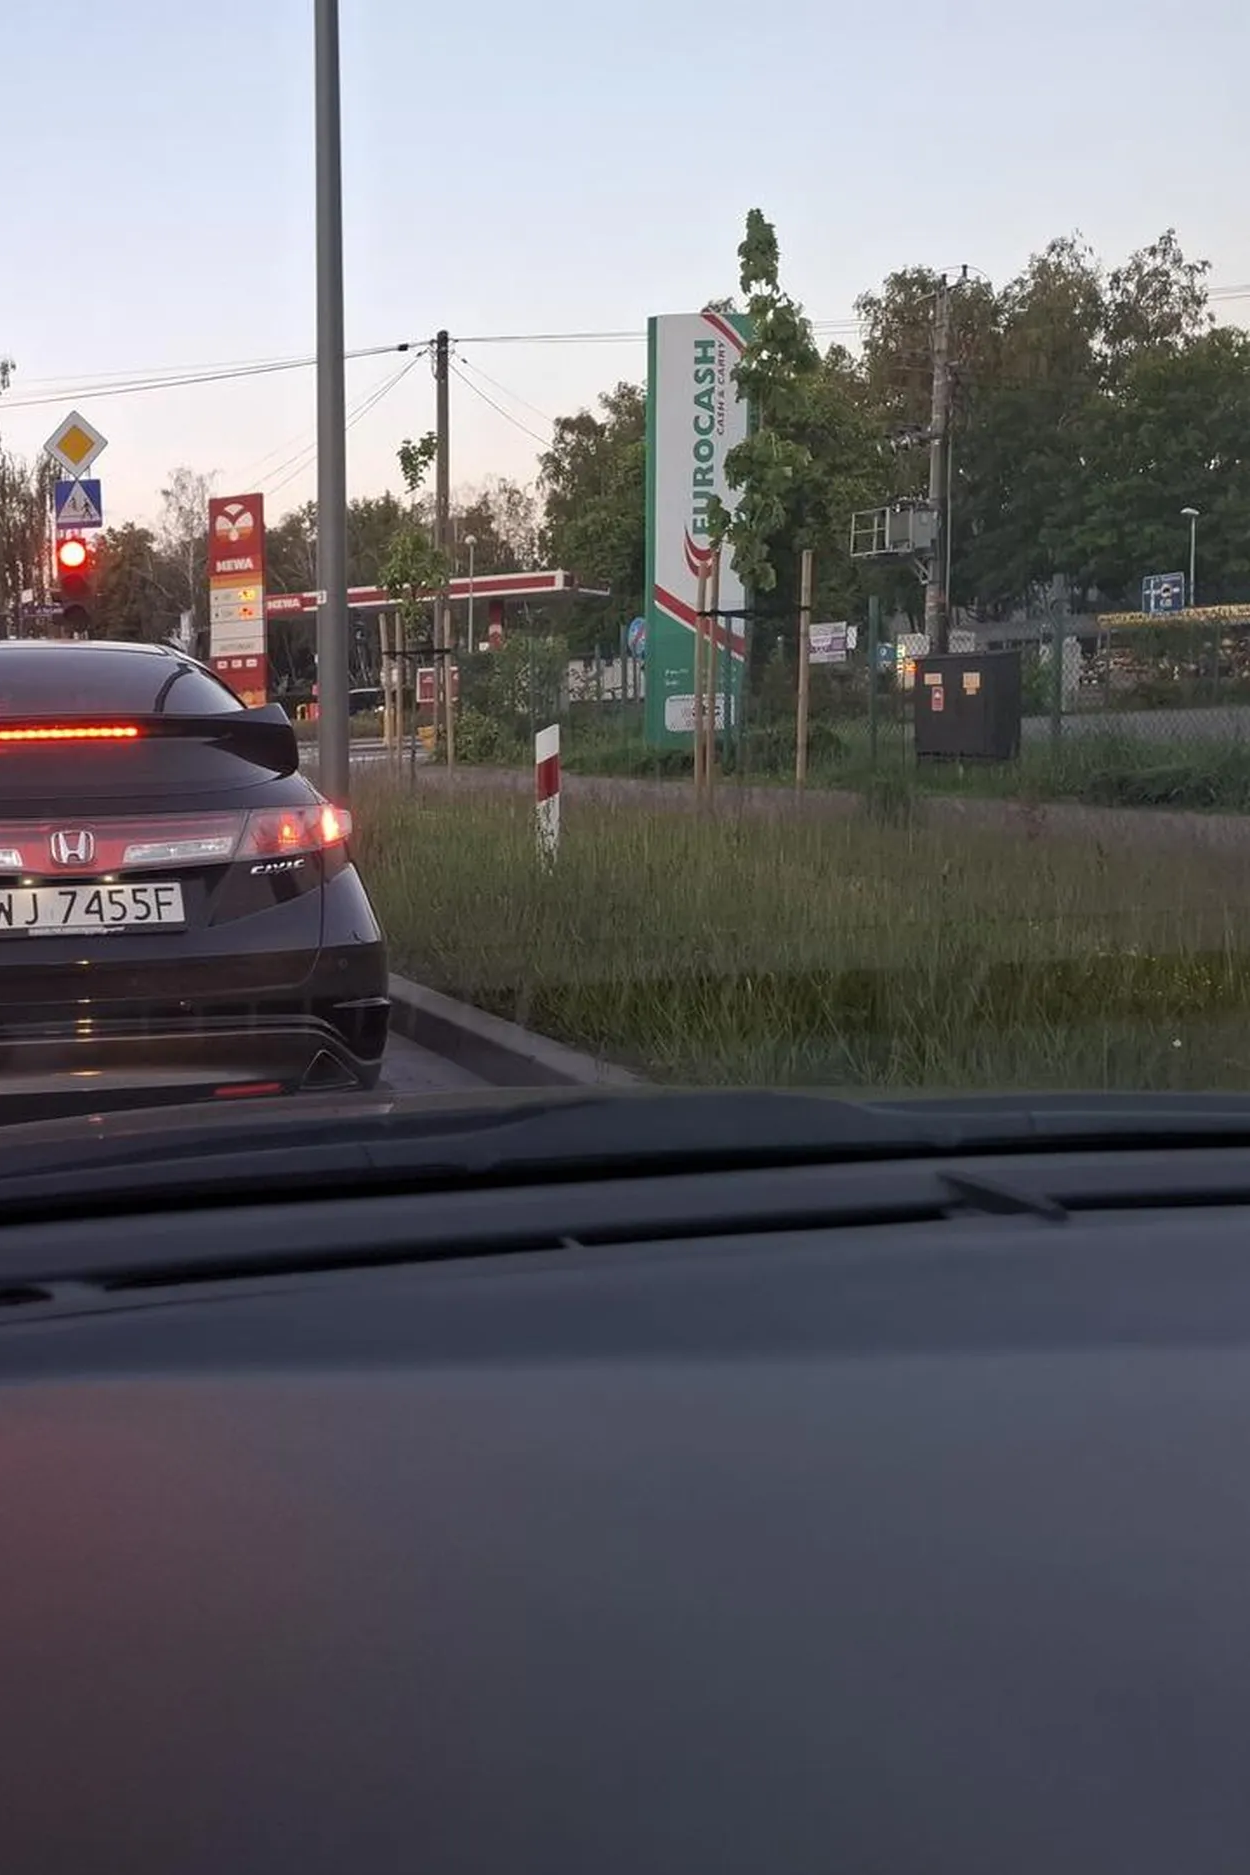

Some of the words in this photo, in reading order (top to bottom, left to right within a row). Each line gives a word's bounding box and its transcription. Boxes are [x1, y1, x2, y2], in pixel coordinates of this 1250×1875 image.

[717, 342, 727, 384] CARRY
[693, 339, 715, 535] EUROCASH
[717, 402, 726, 435] CASH
[250, 858, 306, 875] CIVIC
[58, 887, 175, 925] 7455F
